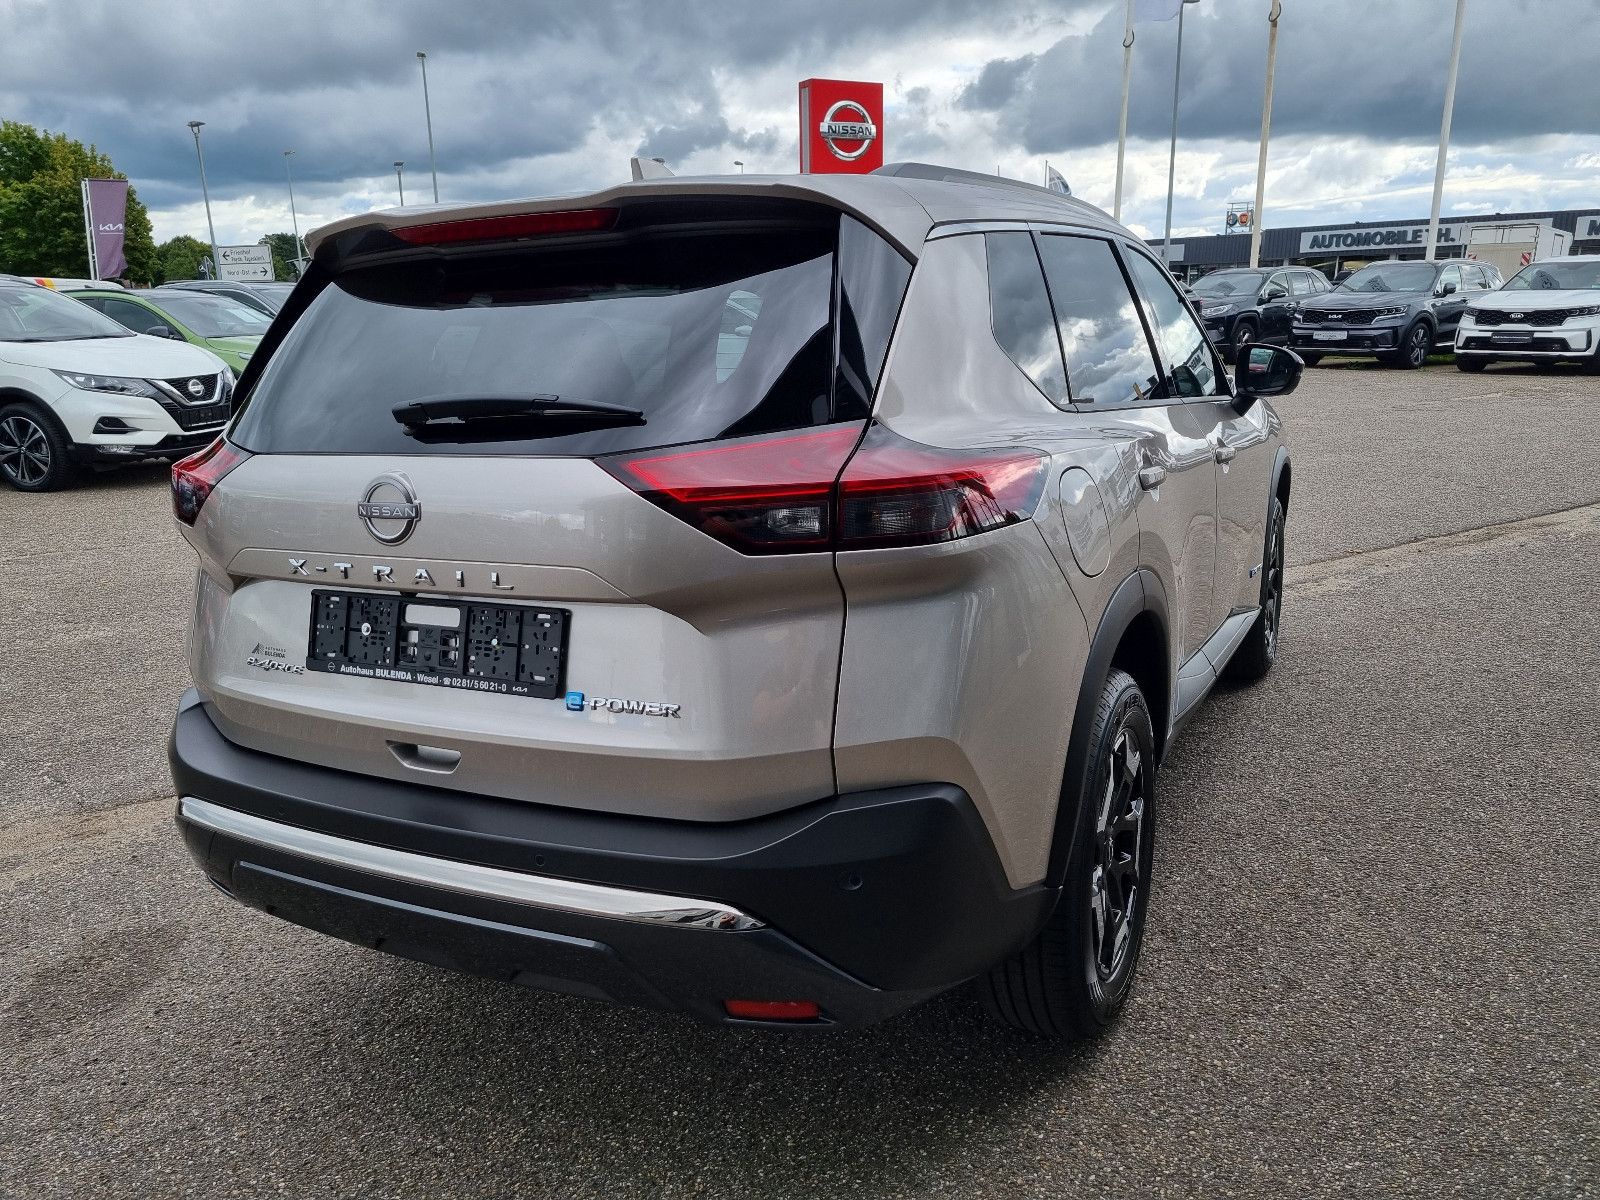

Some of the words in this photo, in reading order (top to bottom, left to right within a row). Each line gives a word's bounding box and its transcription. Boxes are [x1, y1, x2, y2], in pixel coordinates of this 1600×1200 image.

[827, 124, 872, 136] NISSAN
[1309, 228, 1423, 249] AUTOMOBILE
[359, 505, 416, 517] NISSAN
[288, 557, 515, 592] X-TRAIL
[264, 650, 286, 659] BULENDA
[340, 664, 374, 676] Autohaus
[375, 668, 412, 681] BULENDA
[416, 673, 439, 684] Wesel
[566, 691, 681, 719] e-POWER
